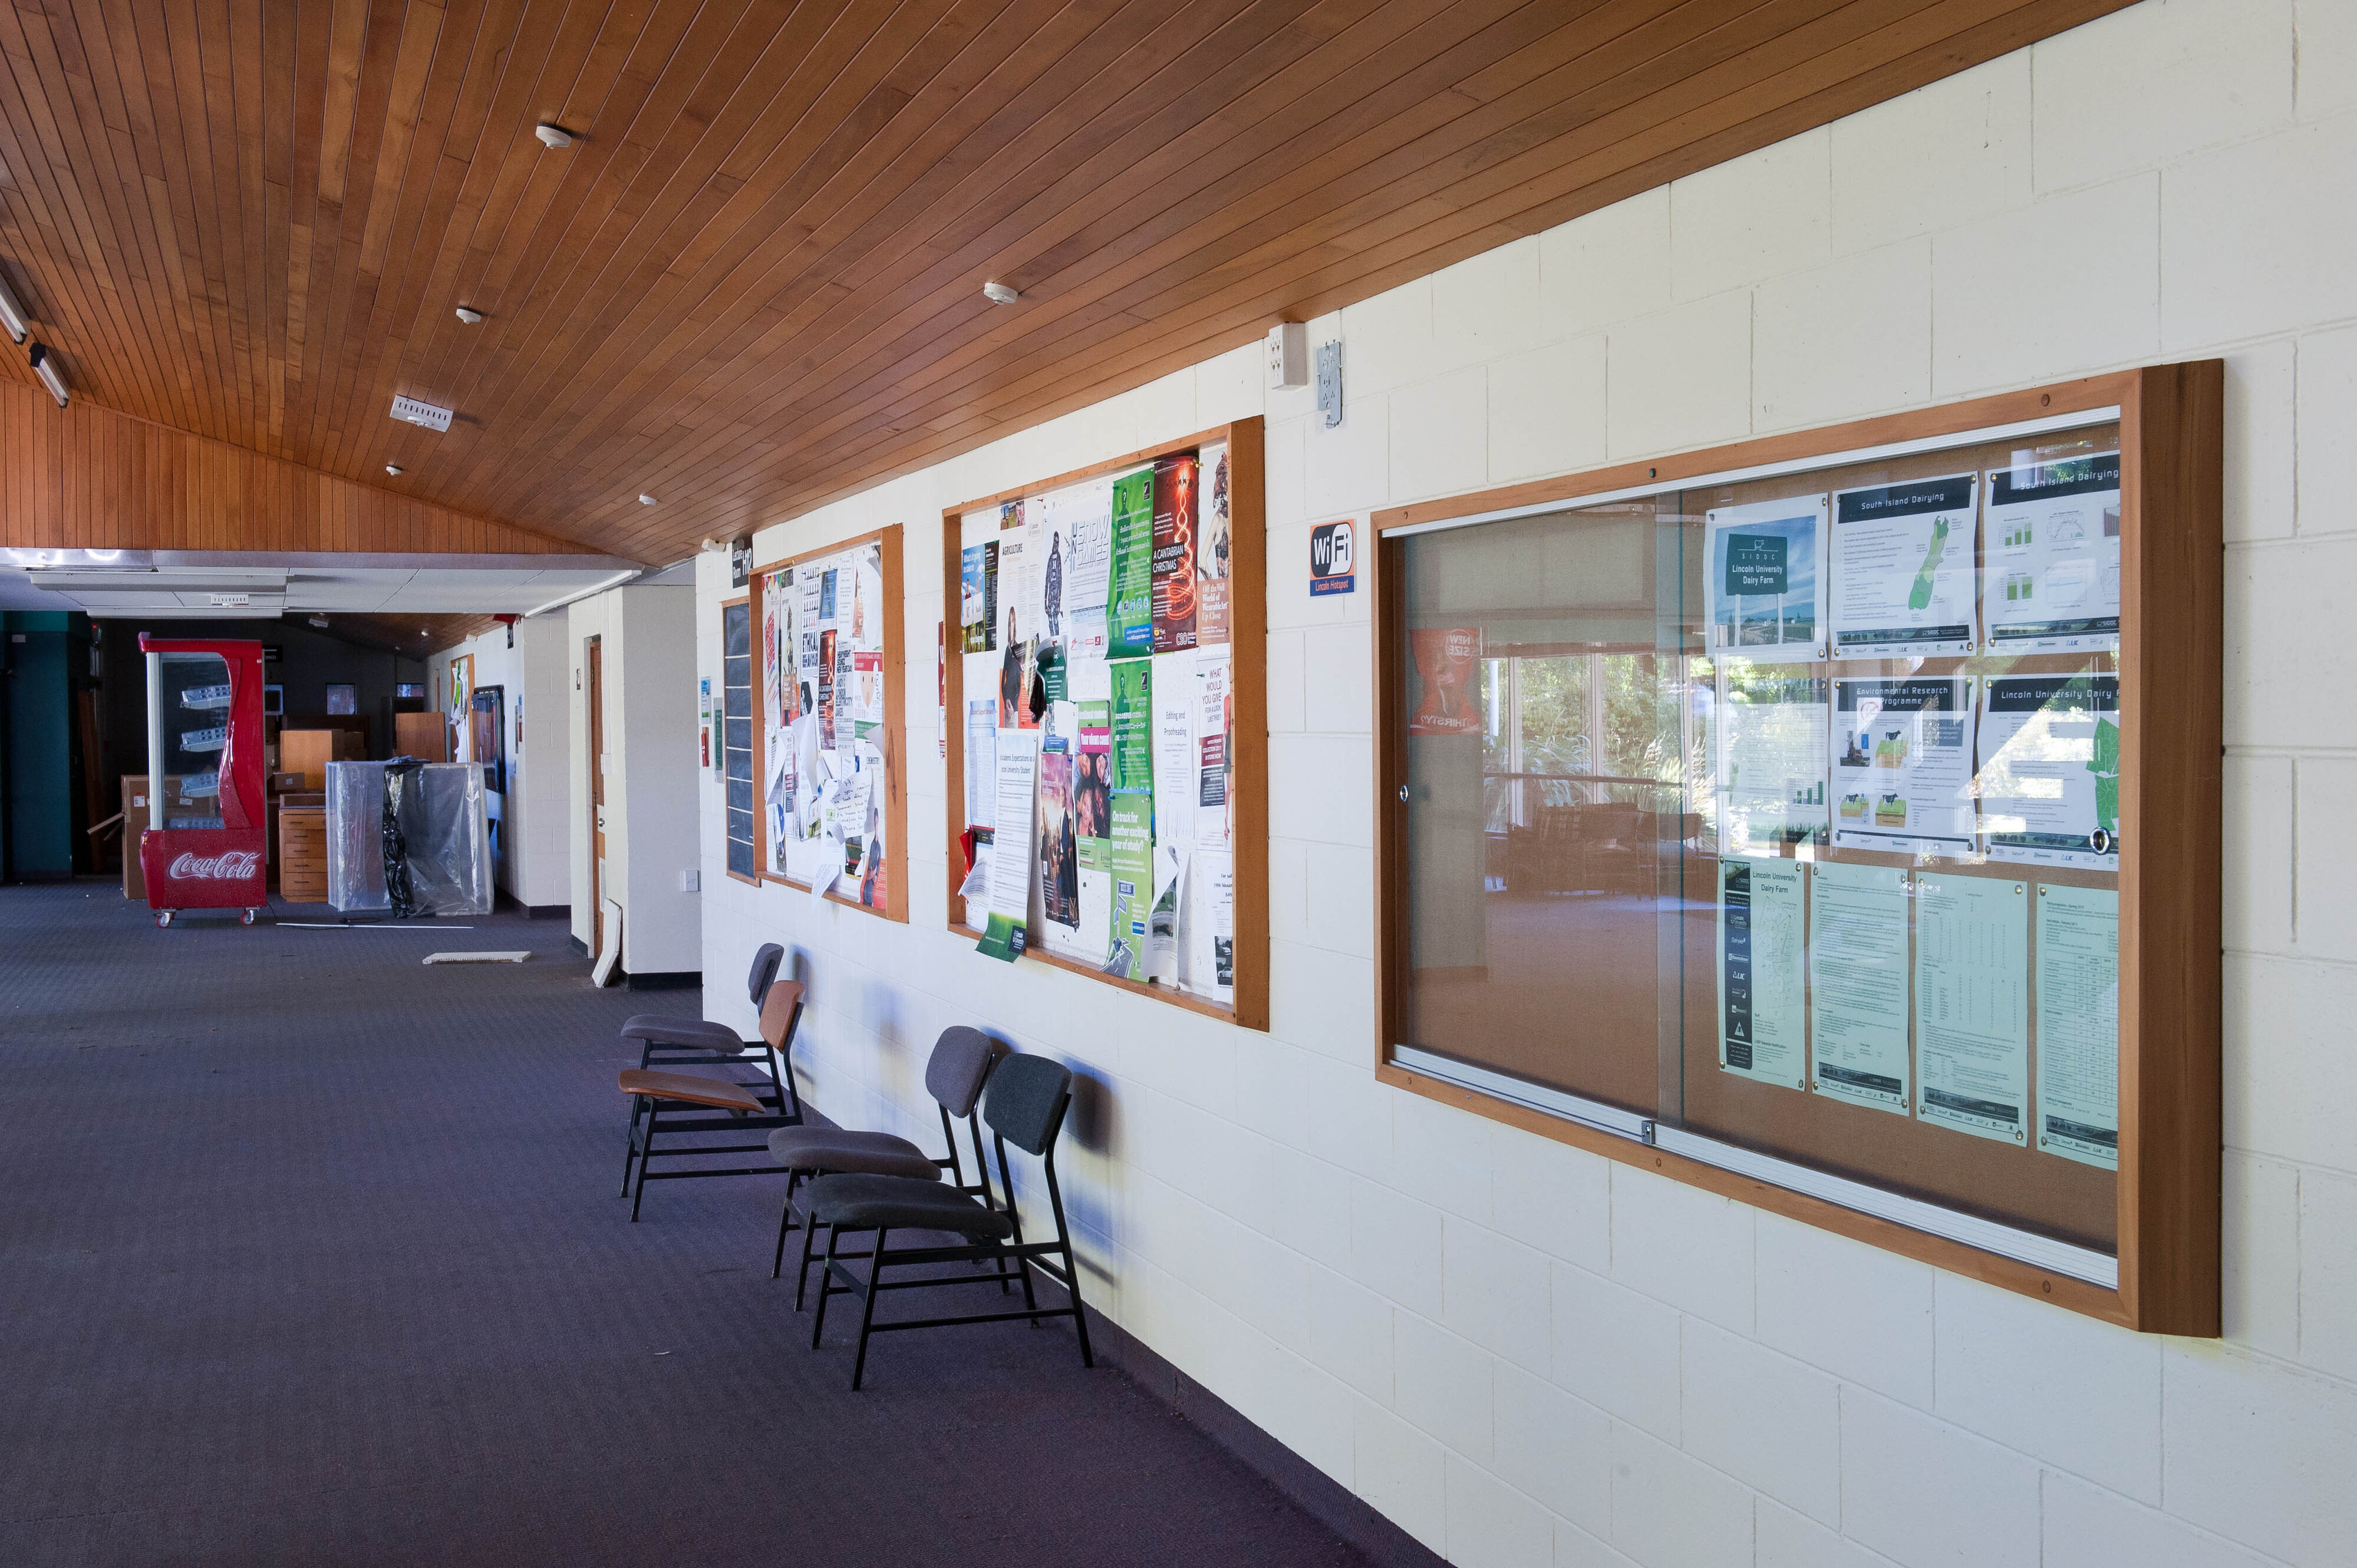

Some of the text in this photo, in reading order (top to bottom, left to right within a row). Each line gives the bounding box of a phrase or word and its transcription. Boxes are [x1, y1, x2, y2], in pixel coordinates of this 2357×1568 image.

[2020, 470, 2119, 490] South Island Dairying
[1862, 493, 1944, 510] South Island Dairying
[733, 549, 742, 561] Lecture
[1002, 543, 1023, 556] AGRICULTURE
[1153, 543, 1184, 560] A CANTABRIAN
[1153, 559, 1176, 573] CHRISTMAS
[1732, 565, 1783, 575] Lincoln University
[1315, 579, 1349, 592] Lincoln Hotspot
[1743, 576, 1773, 586] Dairy Farm
[1202, 592, 1220, 602] World of
[1209, 668, 1222, 679] WHAT
[1206, 680, 1222, 692] WOULD
[1857, 686, 1948, 696] Environmental Research
[1202, 692, 1222, 705] YOU GIVE
[2002, 690, 2032, 699] Lincoln
[2036, 690, 2082, 699] University
[2087, 689, 2112, 698] Dairy
[1881, 697, 1923, 706] Programme
[1166, 710, 1178, 721] Editing
[1164, 727, 1187, 738] Proofreading
[1012, 754, 1029, 763] Expectations
[1007, 767, 1020, 776] University
[1112, 810, 1119, 823] On
[1119, 811, 1130, 823] track
[1112, 825, 1149, 841] another exciting
[1112, 839, 1144, 854] year of study?
[1752, 871, 1798, 883] Lincoln University
[1761, 884, 1788, 893] Dairy Farm
